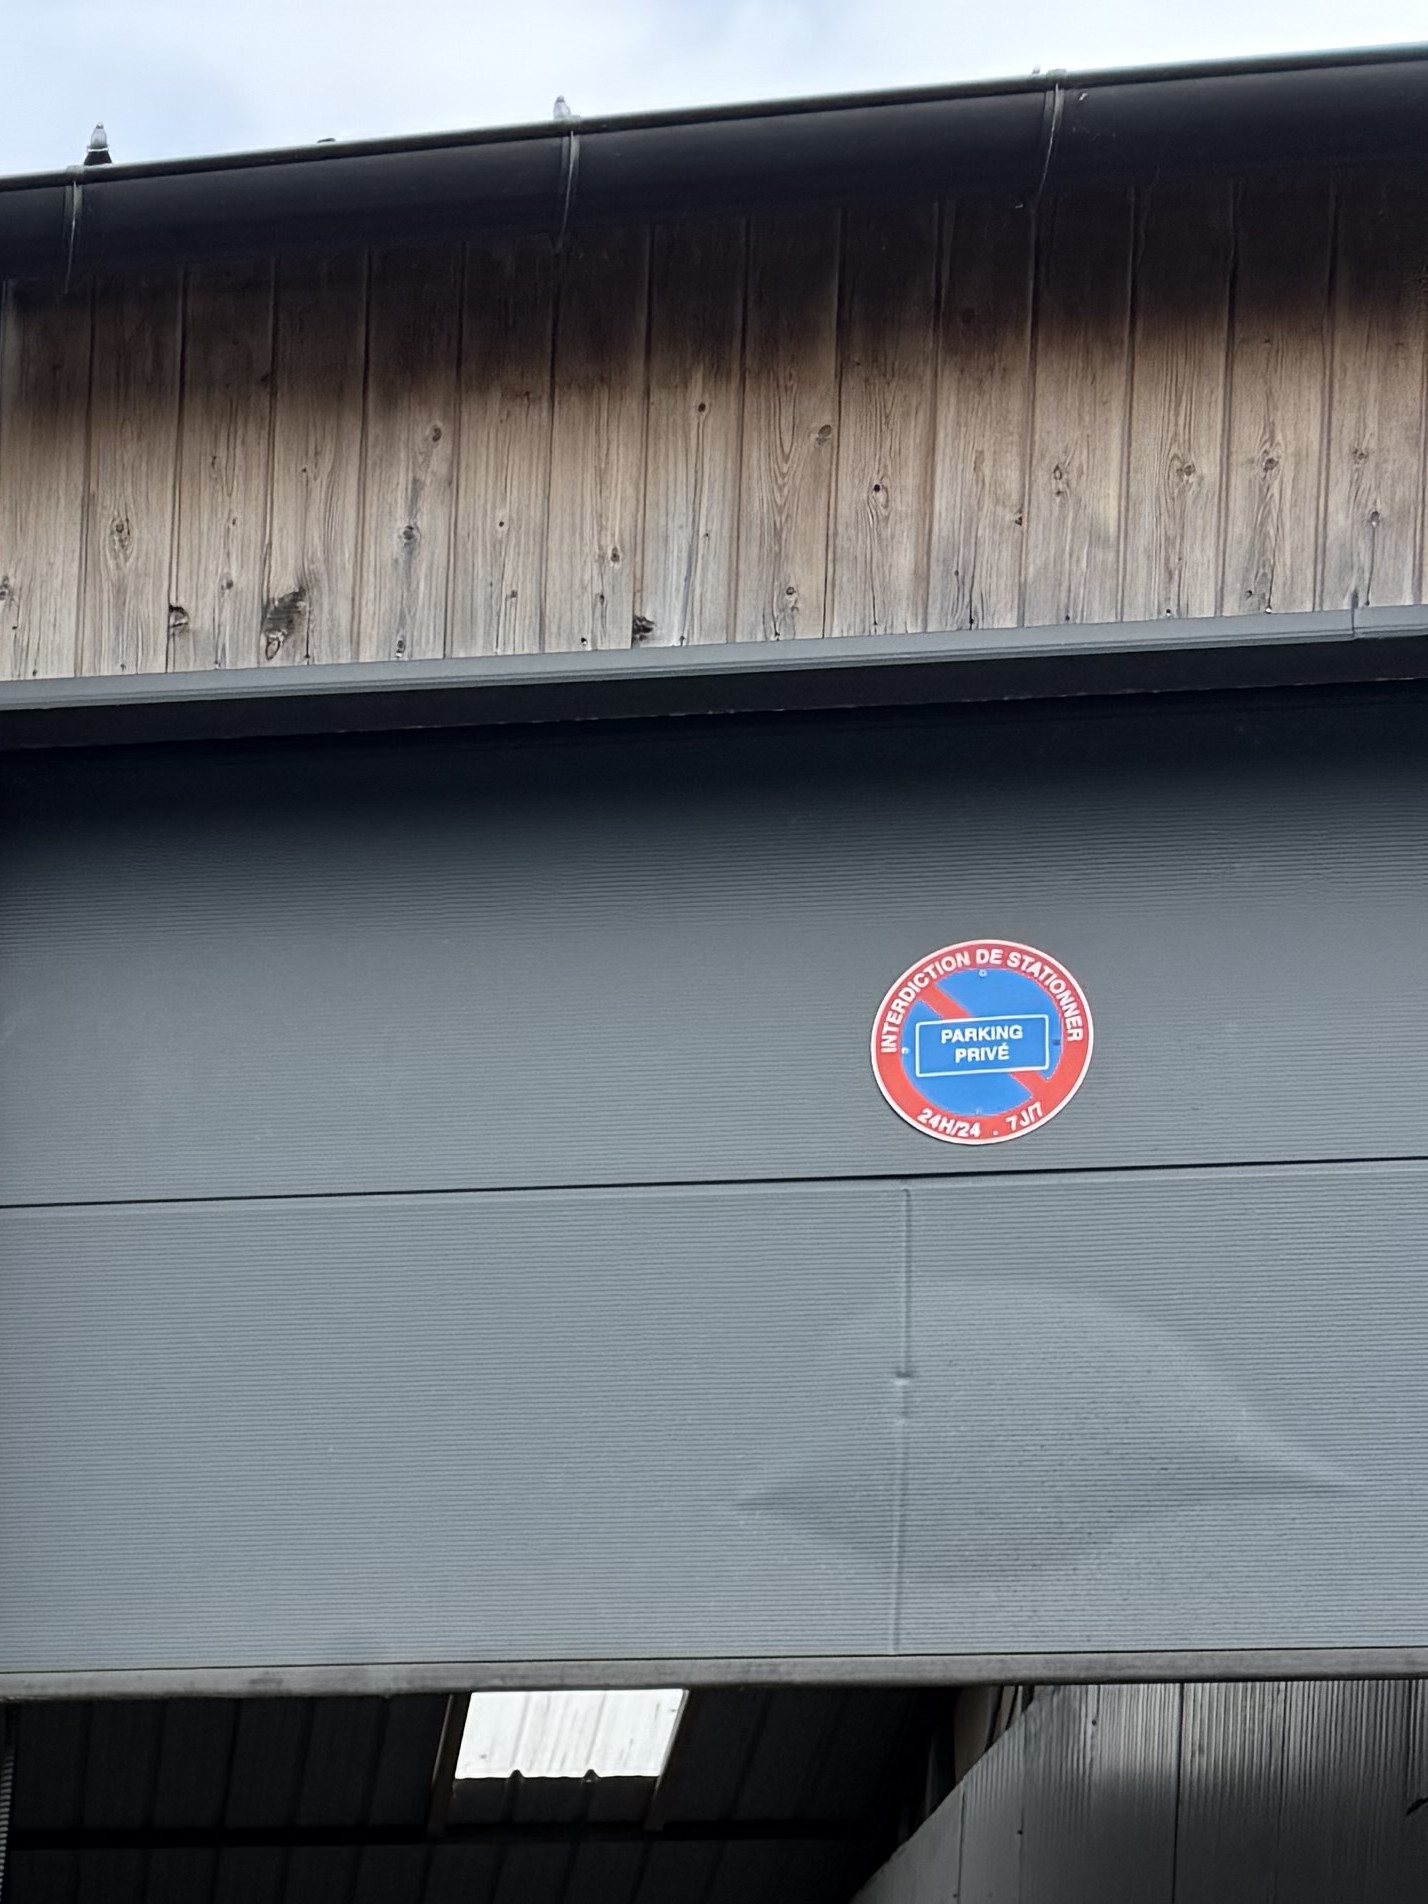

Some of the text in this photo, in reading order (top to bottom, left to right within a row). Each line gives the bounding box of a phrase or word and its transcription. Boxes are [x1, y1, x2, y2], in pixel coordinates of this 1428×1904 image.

[881, 948, 1084, 1054] INTERDICTION DE STATIONNER
[941, 1024, 1023, 1044] PARKING
[955, 1043, 1010, 1064] PRIVÉ
[916, 1100, 1044, 1138] 24H/24 7J/7
